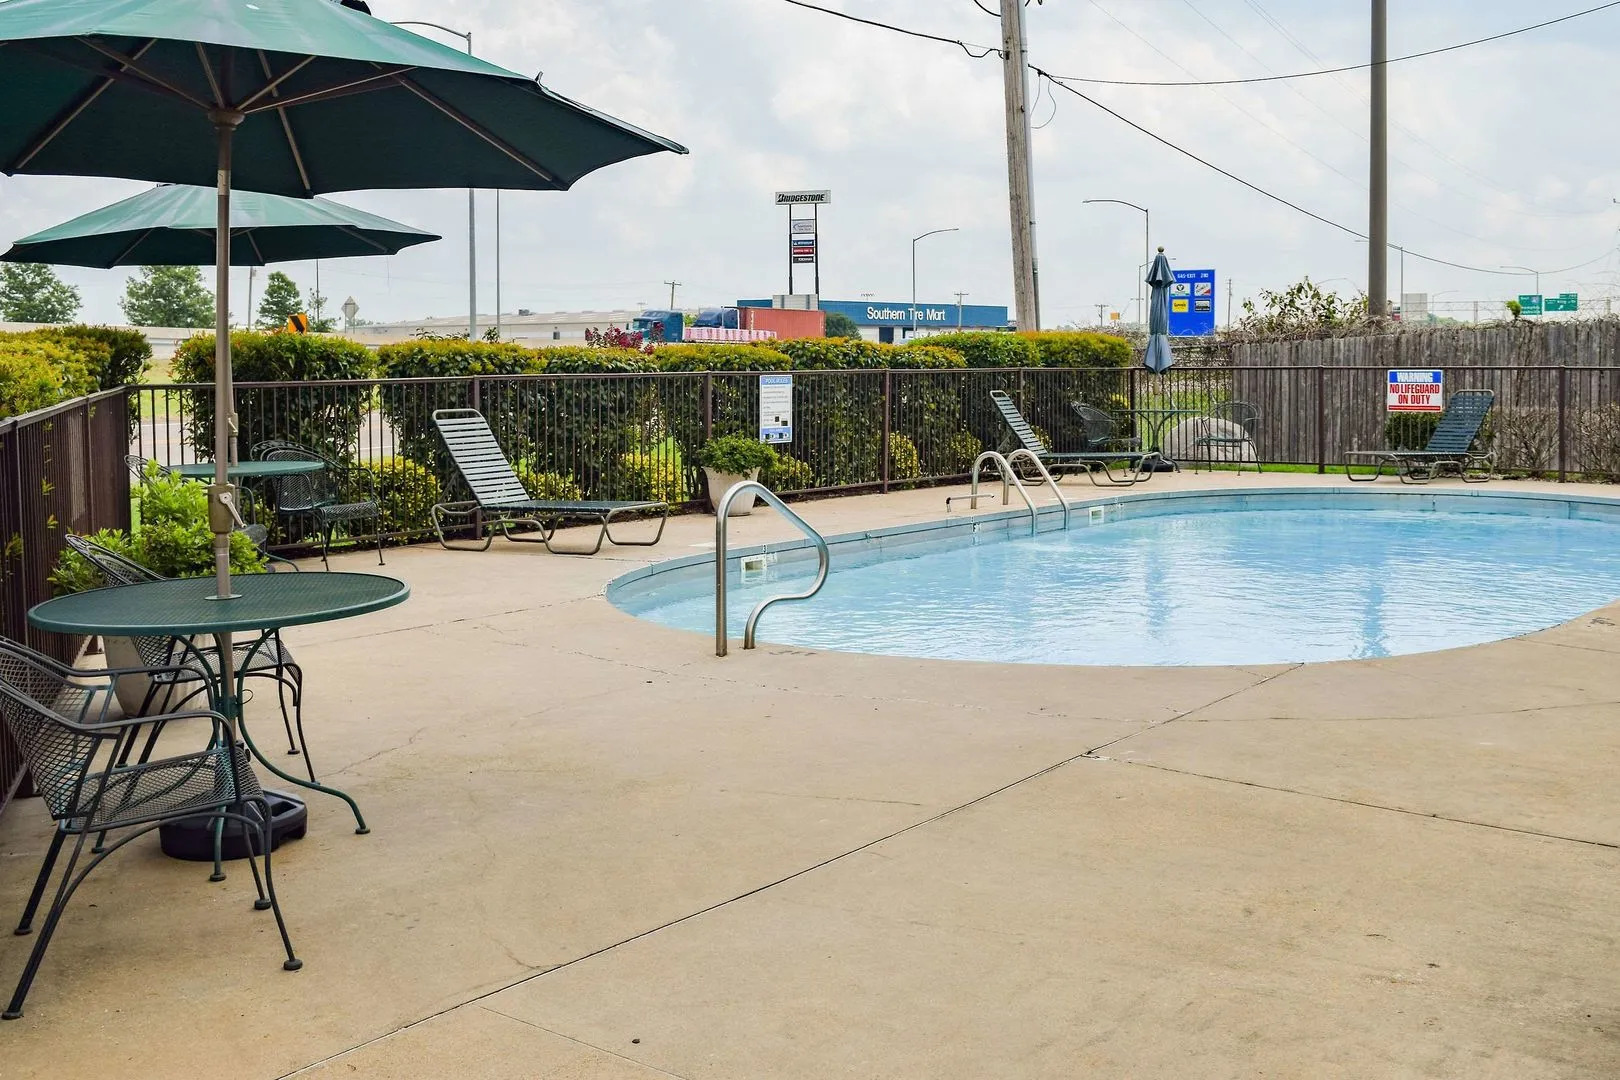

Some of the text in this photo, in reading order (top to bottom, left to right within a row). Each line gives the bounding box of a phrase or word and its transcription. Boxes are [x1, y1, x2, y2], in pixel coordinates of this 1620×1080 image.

[777, 193, 825, 203] BRIDGESTONE
[866, 306, 946, 321] Southern Tre Mart
[1397, 372, 1433, 382] WARNING
[1390, 384, 1440, 394] NO LIFEGUARD
[1398, 395, 1430, 404] ON DUTY
